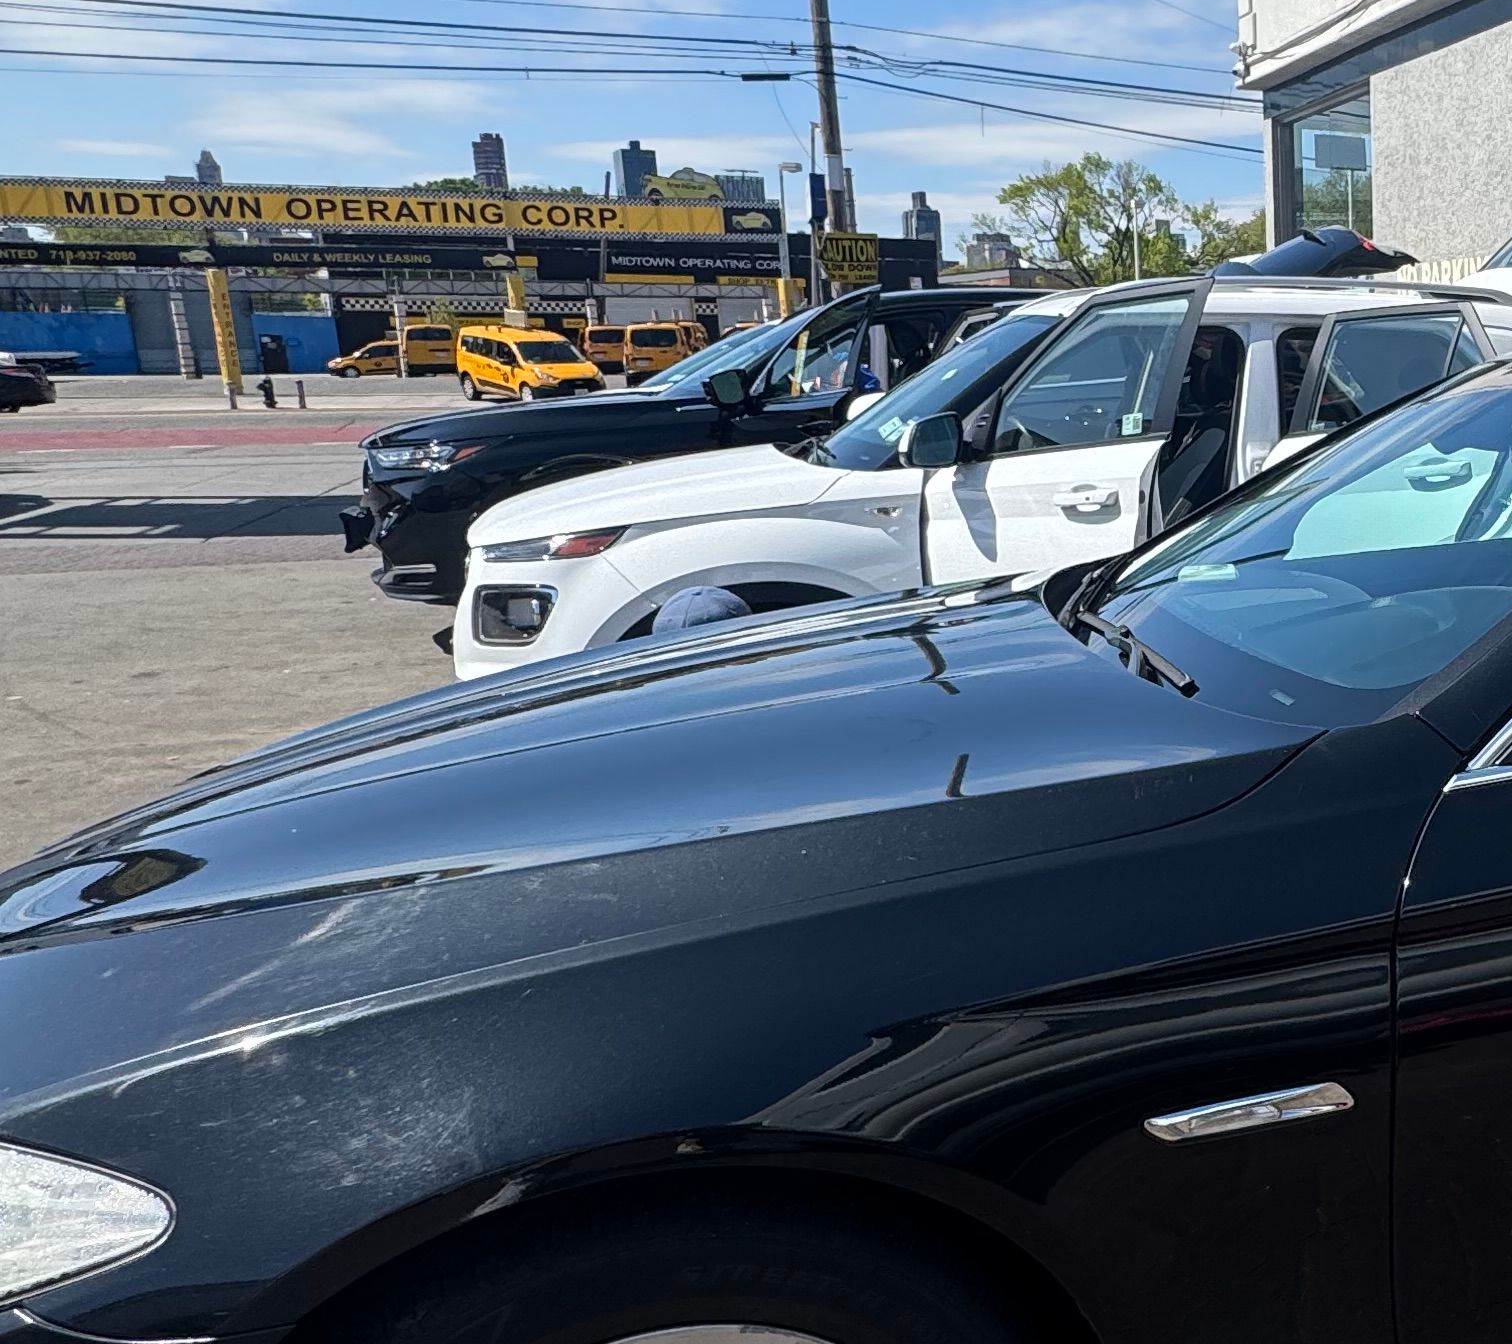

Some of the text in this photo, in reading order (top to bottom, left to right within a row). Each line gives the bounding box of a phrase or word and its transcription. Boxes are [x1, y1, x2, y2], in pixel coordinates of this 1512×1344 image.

[64, 191, 625, 229] MIDTOWN OPERATING CORP.
[273, 253, 308, 263] DAILY
[324, 253, 375, 263] WEEKLY
[379, 254, 432, 265] LEASING
[611, 256, 787, 271] MIDTOWN OPERATING COR
[1421, 256, 1487, 285] PARKIN
